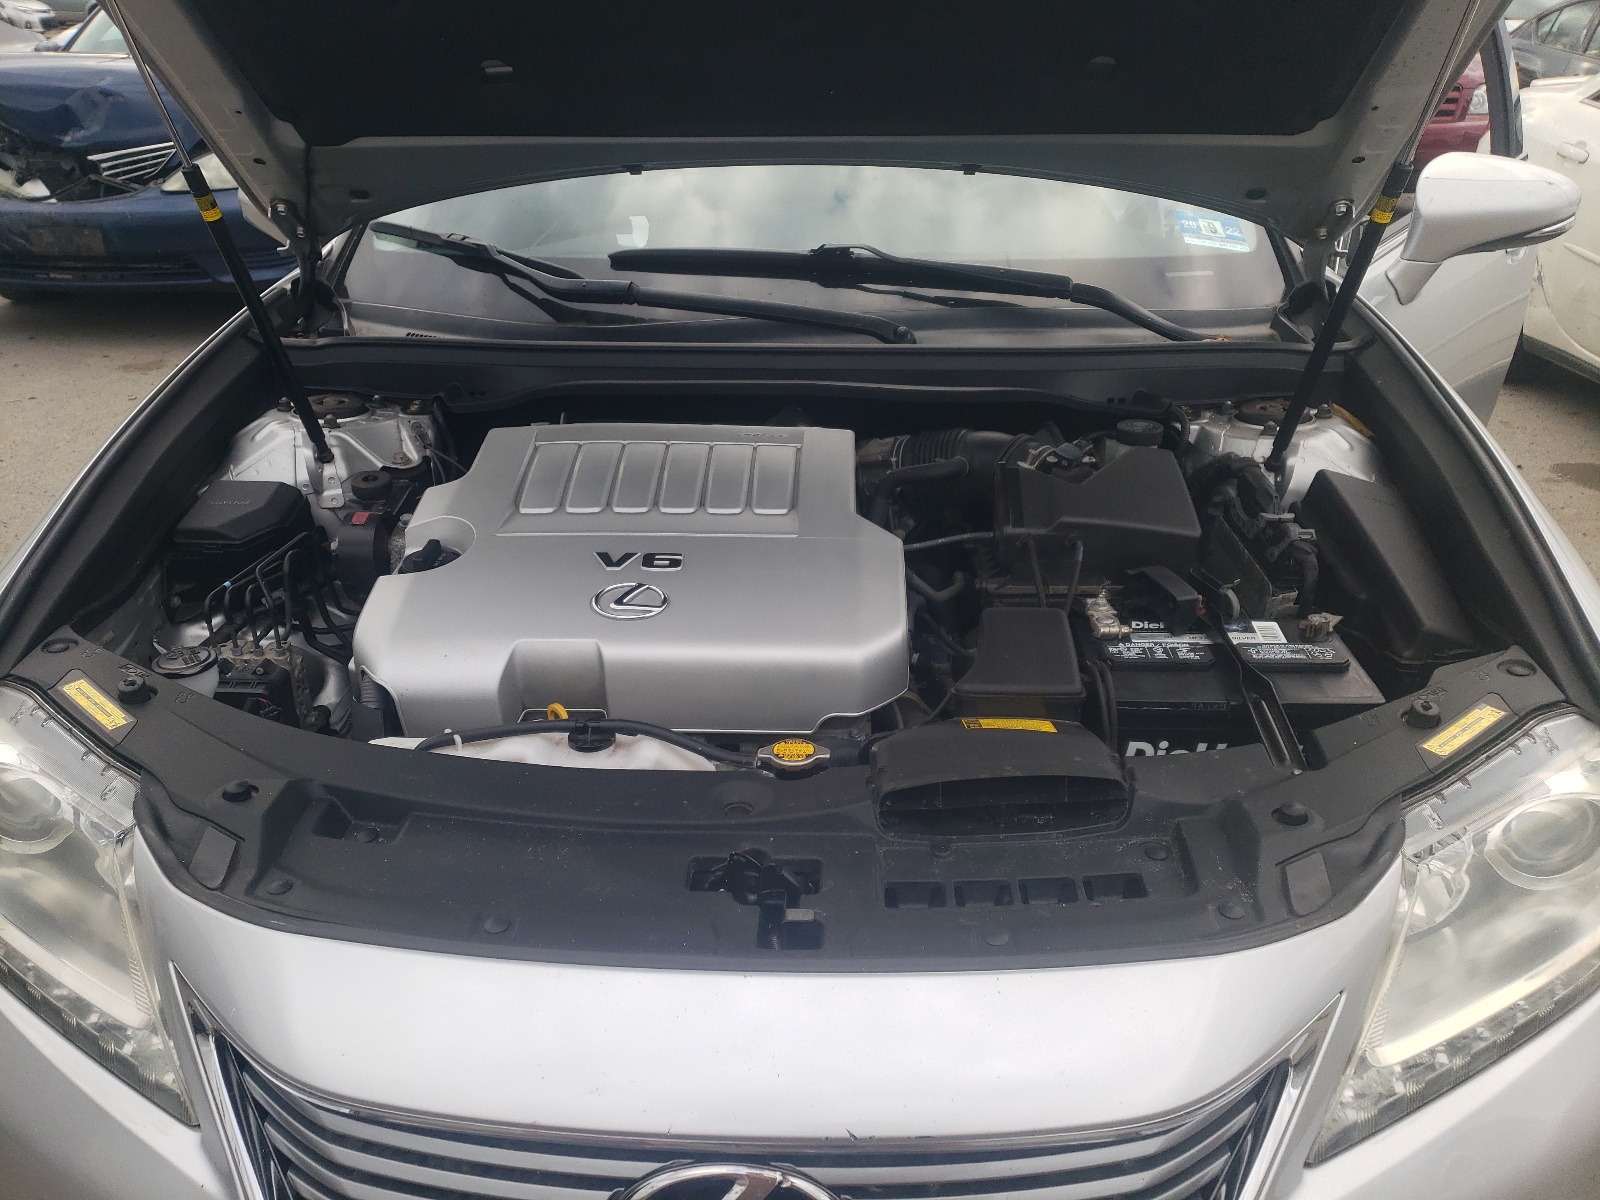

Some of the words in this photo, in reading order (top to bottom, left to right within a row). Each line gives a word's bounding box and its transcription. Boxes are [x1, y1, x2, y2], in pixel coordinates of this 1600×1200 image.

[1181, 219, 1197, 229] 20
[1207, 221, 1218, 234] 9
[1224, 226, 1242, 236] 22
[593, 551, 684, 571] V6
